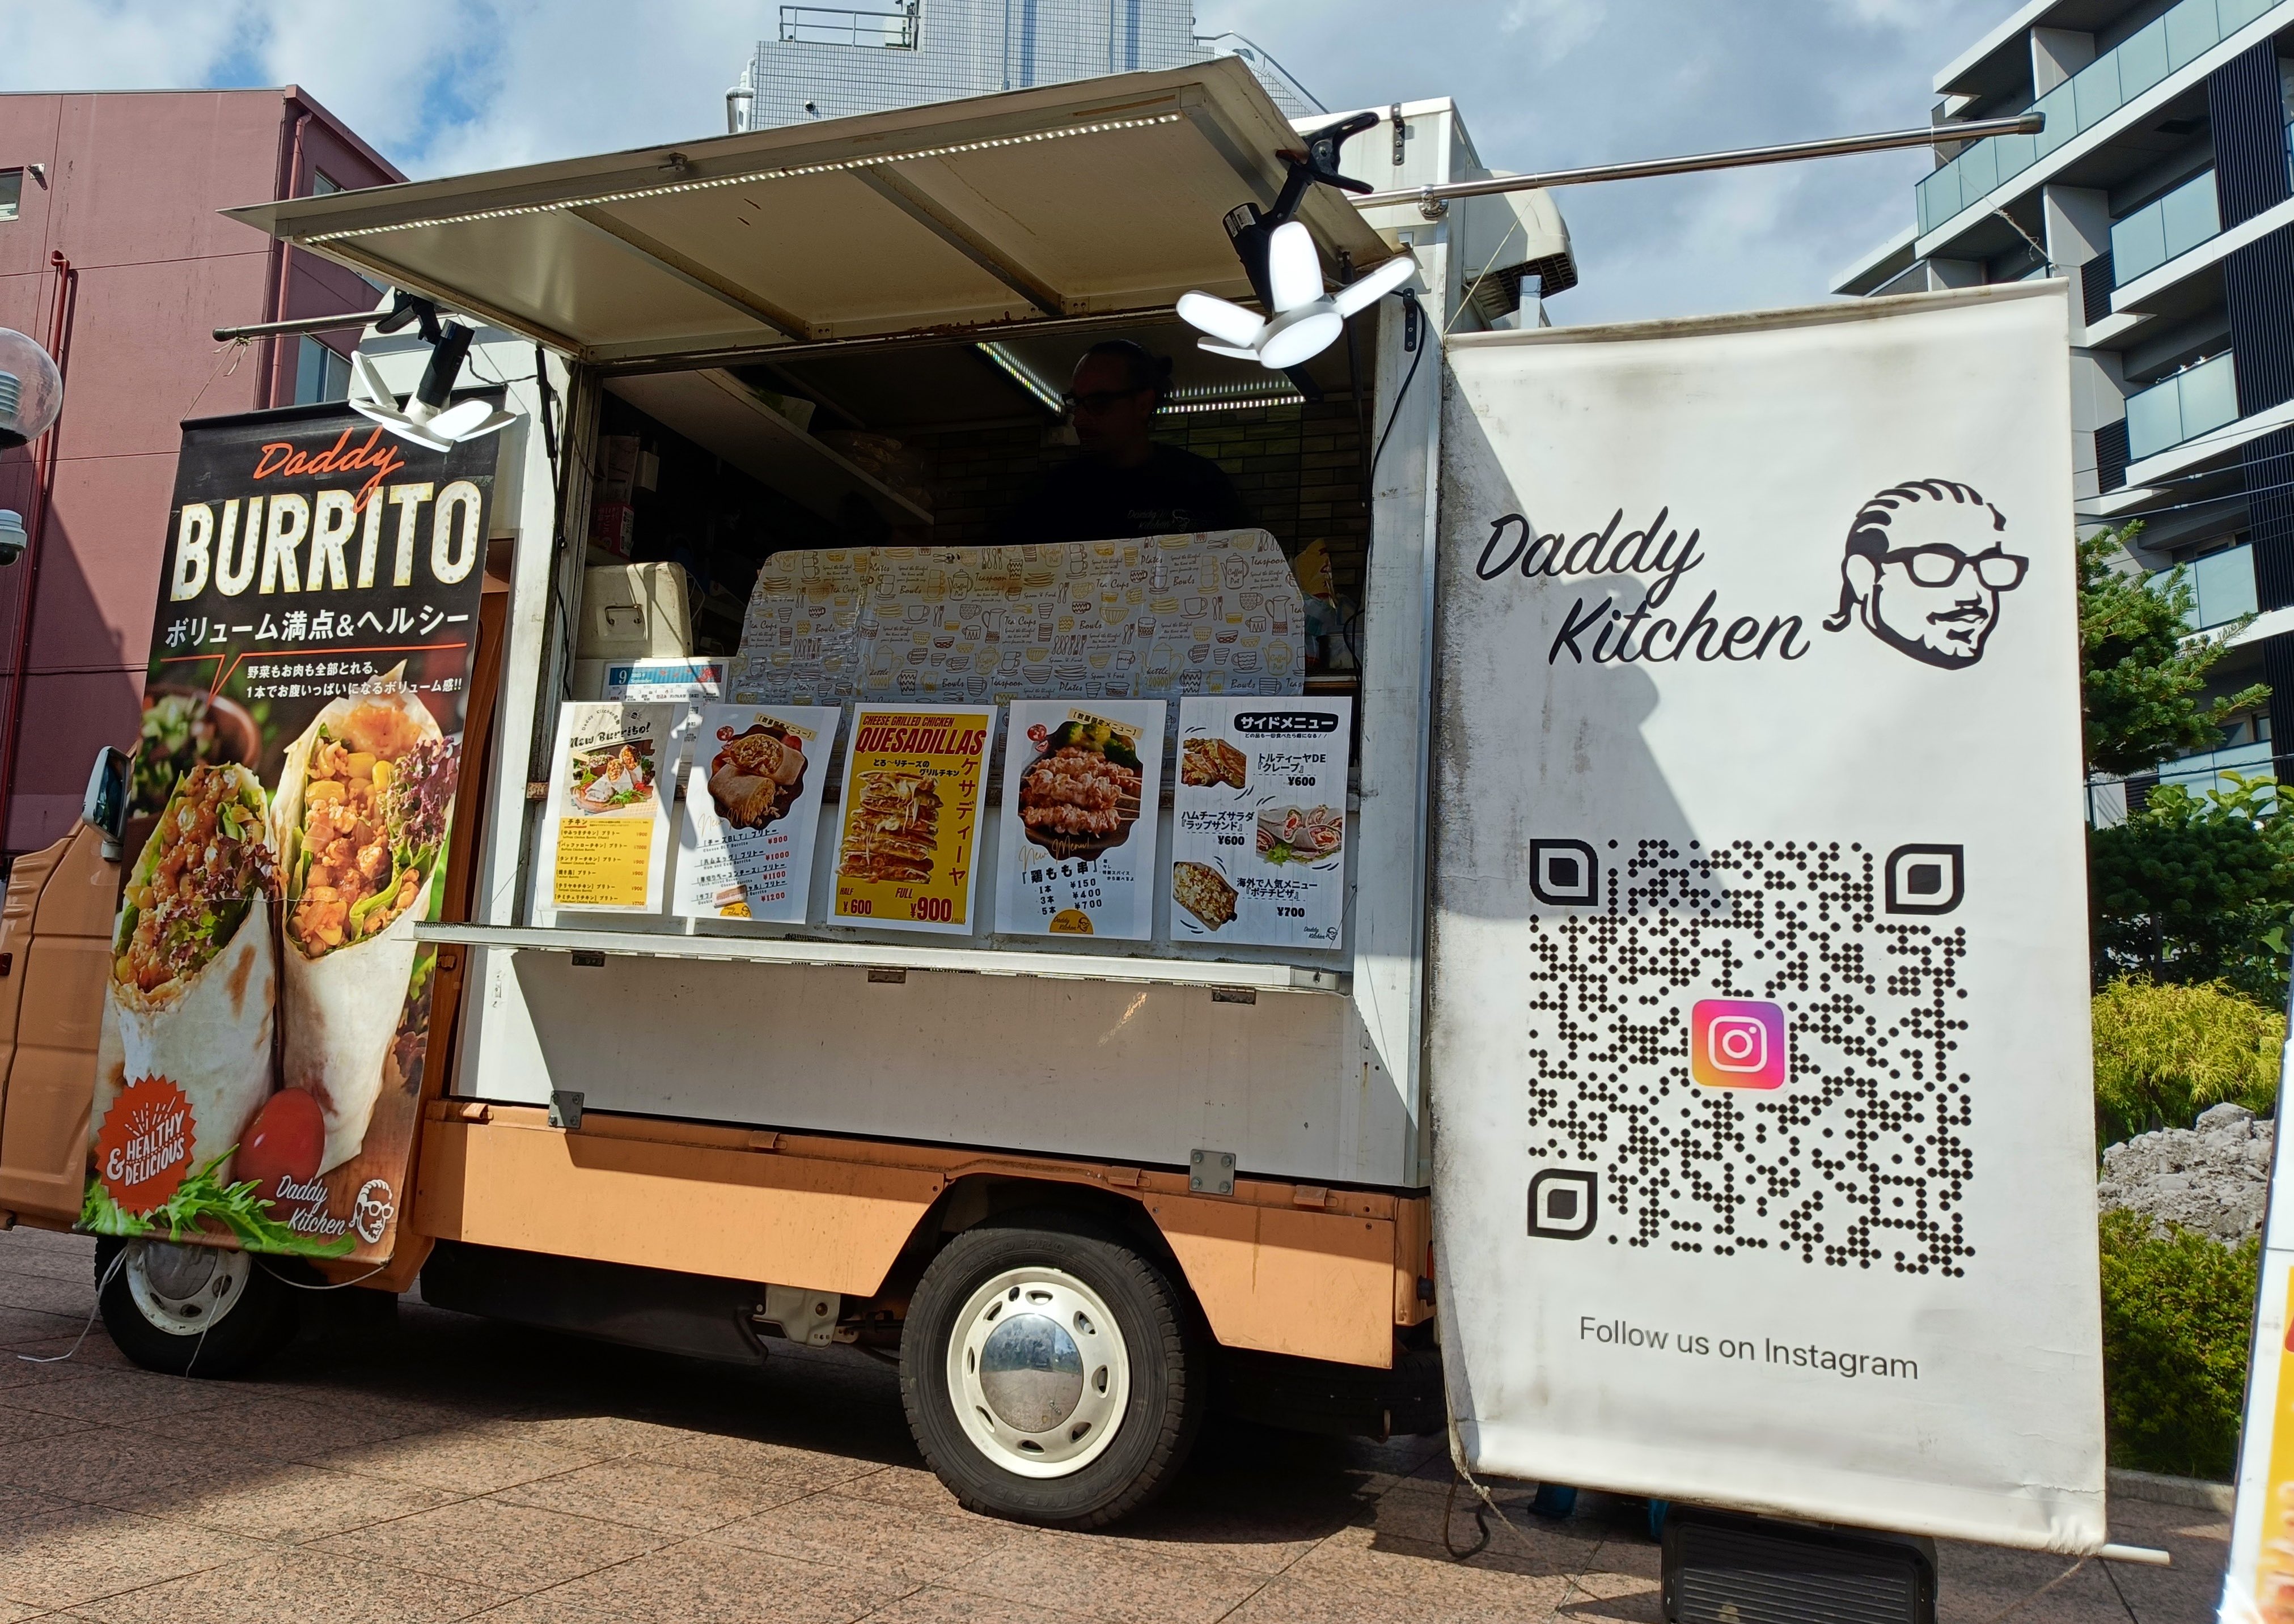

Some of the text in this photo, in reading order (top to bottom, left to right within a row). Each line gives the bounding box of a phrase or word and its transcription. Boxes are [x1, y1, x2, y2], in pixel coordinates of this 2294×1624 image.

[253, 422, 405, 513] Daddy
[170, 481, 481, 602] BURRITO
[1141, 555, 1162, 565] Plates
[1251, 556, 1286, 567] Teaspoon
[1474, 505, 1704, 609] Daddy
[975, 573, 1007, 582] Teaspoon
[1174, 574, 1195, 586] Bowls
[842, 584, 859, 594] Cups
[900, 586, 921, 594] Bowls
[1097, 579, 1129, 590] Tea Cups
[165, 604, 469, 648] ボリューム満点&ヘルシー
[760, 621, 777, 629] Cups
[1005, 616, 1036, 626] Tea Cups
[1080, 620, 1102, 630] Bowls
[815, 624, 835, 633] Bowls
[1548, 590, 1810, 665] Kitchen
[247, 662, 379, 679] 野菜もお肉も全部とれる、
[619, 670, 627, 684] 9
[991, 677, 1023, 688] Teaspoon
[247, 677, 462, 699] 1本でお腹いっぱいになるボリューム感!!
[942, 679, 964, 688] Bowls
[1059, 682, 1082, 692] Plates
[1231, 680, 1255, 689] Bowls
[863, 716, 955, 727] CHEESE GRILLED CHICKEN
[1241, 716, 1334, 730] サイドメニュー
[570, 722, 651, 748] New Burrito!
[855, 727, 987, 755] QUESADILLAS
[1259, 753, 1326, 763] トルティーヤDE
[1258, 762, 1303, 773] 『クレープ』
[1288, 777, 1315, 786] ¥600
[1181, 811, 1255, 822] ハムチーズサラダ
[949, 758, 978, 887] ケサディーヤ
[1182, 819, 1243, 832] 『ラップサンド』
[751, 829, 777, 838] ブリトー
[768, 836, 788, 845] ¥900
[1218, 836, 1245, 845] ¥600
[741, 850, 764, 859] ブリトー
[765, 851, 790, 860] ¥1000
[763, 871, 786, 880] ¥1100
[1022, 860, 1097, 884] 『鶏もも串』
[1039, 879, 1096, 894] 1本 ¥150
[1237, 877, 1318, 889] 海外で人気メニュー
[761, 892, 785, 902] ¥1200
[895, 888, 913, 898] FULL
[1040, 888, 1101, 904] 3本 ¥400
[910, 897, 952, 922] ¥900
[1042, 899, 1102, 915] 5本 ¥700
[1277, 907, 1305, 917] ¥700
[1053, 916, 1070, 925] Daddy
[126, 1109, 184, 1160] HEALTHY
[107, 1137, 184, 1186] & DELICIOUS
[276, 1174, 328, 1214] Daddy
[287, 1207, 346, 1236] Kitchen
[1581, 1316, 1918, 1380] Follow us on Instagram
